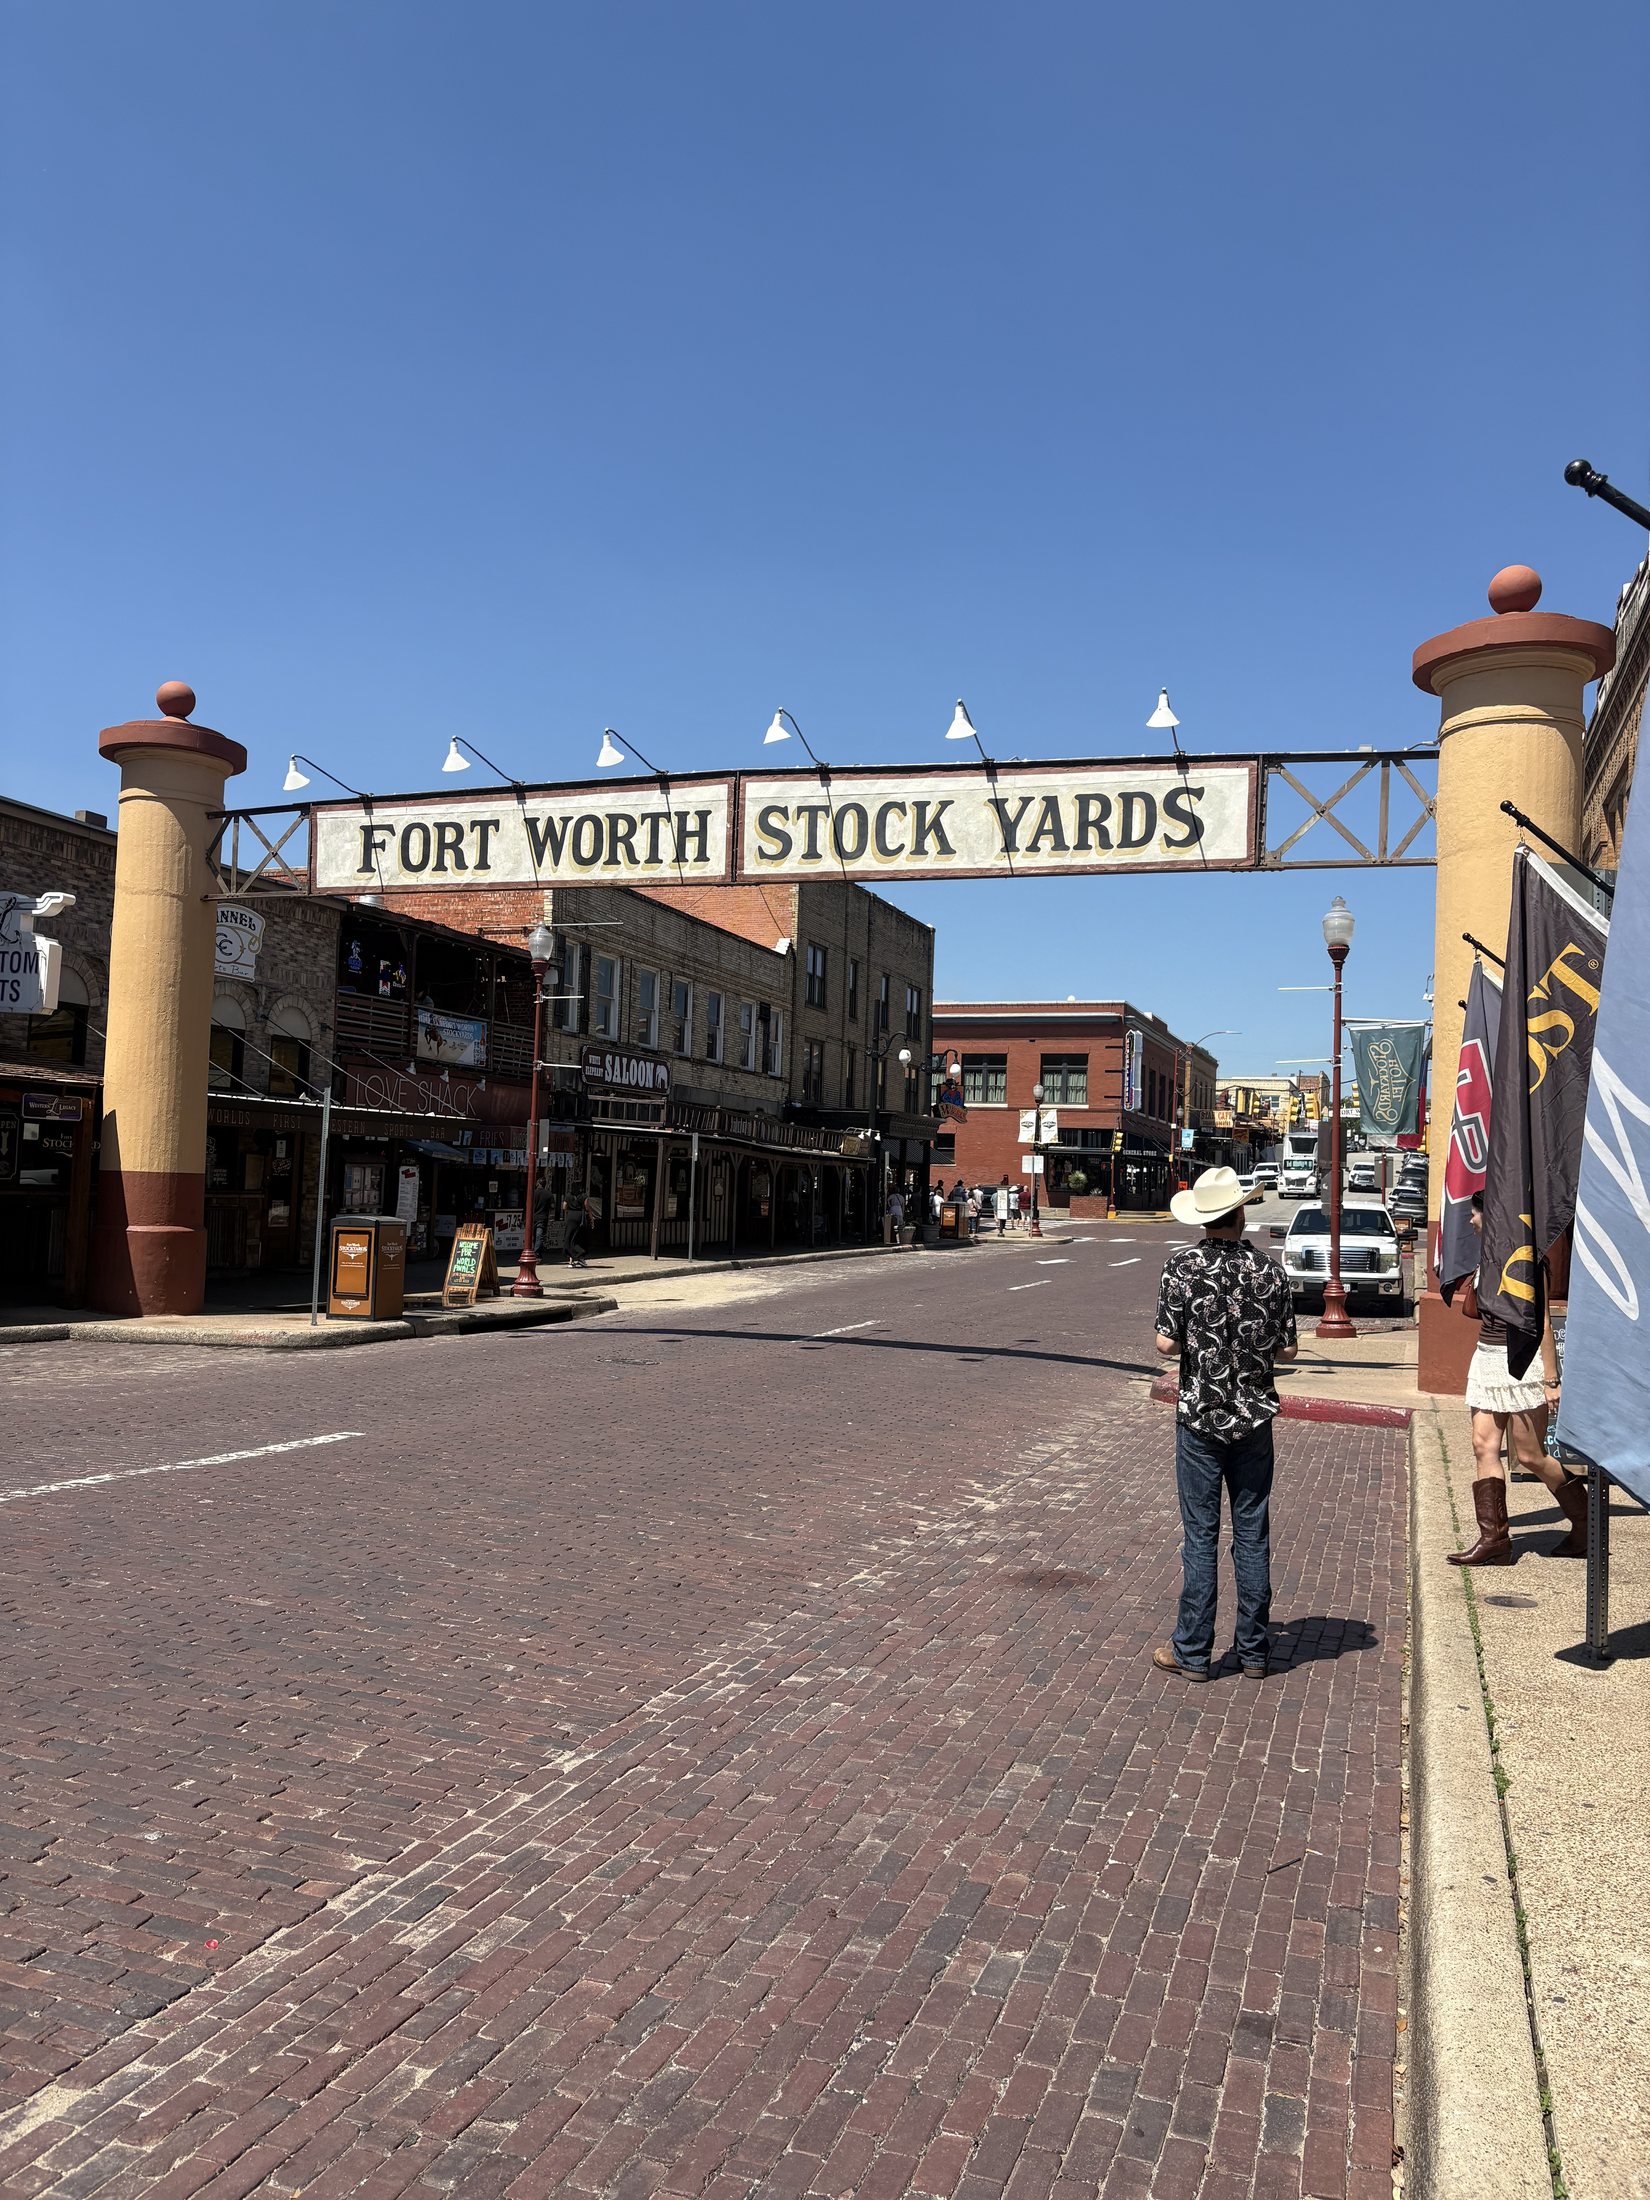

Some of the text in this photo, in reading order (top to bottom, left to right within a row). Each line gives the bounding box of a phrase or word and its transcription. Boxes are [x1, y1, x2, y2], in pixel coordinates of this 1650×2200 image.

[358, 809, 712, 873] FORT WORTH
[757, 786, 1206, 861] STOCK YARDS
[605, 1054, 655, 1088] SALOON
[355, 1074, 478, 1116] LOVE SHACK
[273, 1113, 303, 1129] FIRST
[329, 1117, 365, 1135] ESTERN
[384, 1122, 415, 1137] SPORTS
[430, 1126, 445, 1138] BAR
[456, 1257, 477, 1266] WORLD
